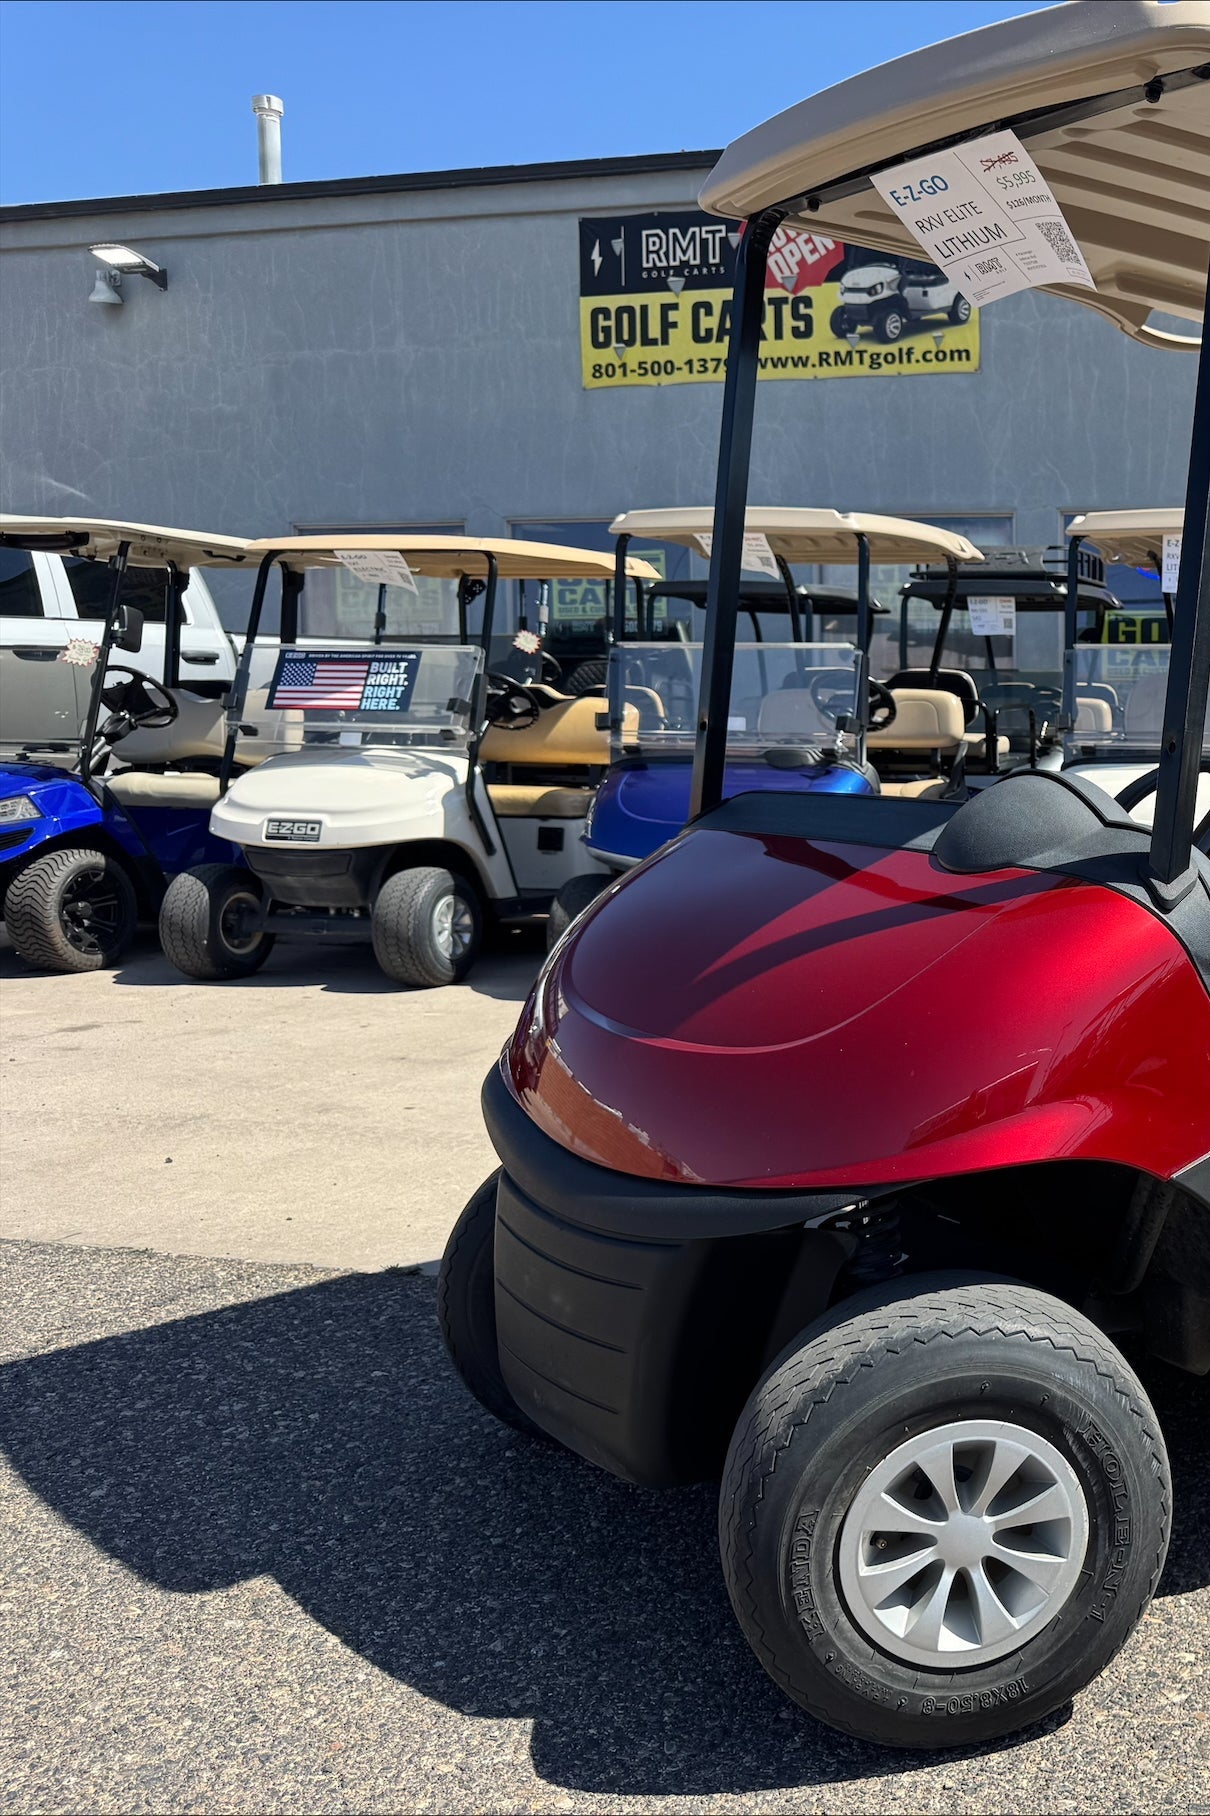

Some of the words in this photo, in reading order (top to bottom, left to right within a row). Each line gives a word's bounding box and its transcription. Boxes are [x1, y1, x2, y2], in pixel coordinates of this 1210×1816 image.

[889, 174, 949, 207] E-Z-GO
[996, 170, 1036, 191] $5,995
[1006, 194, 1052, 210] $126/MONTH
[914, 212, 944, 235] RXV
[642, 225, 727, 268] RMT
[934, 222, 1008, 260] LITHIUM
[768, 232, 836, 284] OPEN
[684, 266, 725, 276] CARTS
[590, 302, 680, 350] GOLF
[691, 295, 814, 345] CATS
[370, 661, 409, 674] BUILT
[366, 673, 409, 686] RIGHT.
[364, 686, 405, 698] RIGHT
[360, 698, 400, 710] HERE.
[789, 1510, 825, 1644] KENDA
